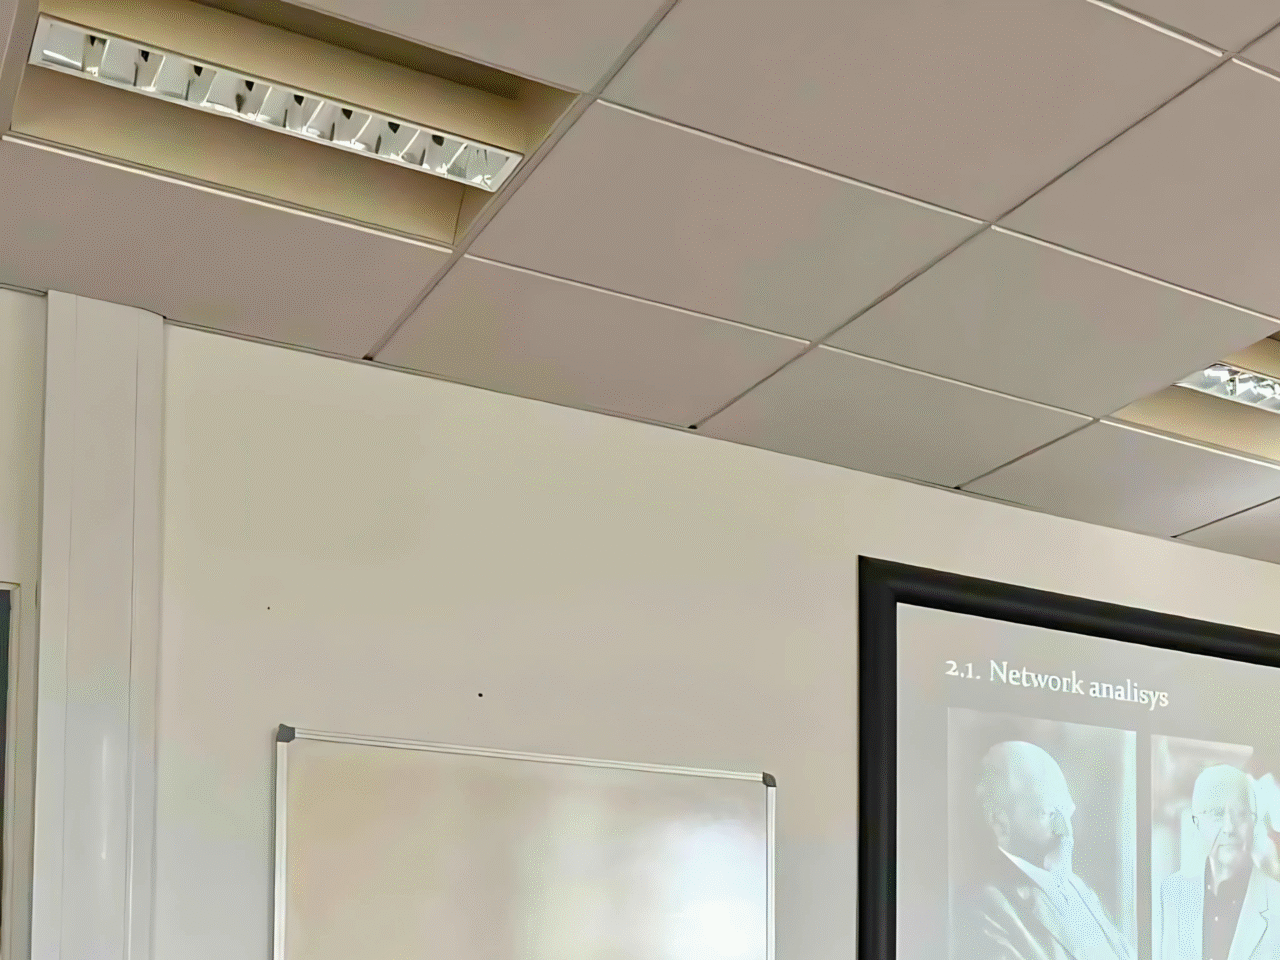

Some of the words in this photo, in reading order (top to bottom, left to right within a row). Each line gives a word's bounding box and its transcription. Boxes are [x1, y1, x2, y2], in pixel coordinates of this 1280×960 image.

[945, 660, 981, 680] 2.1.
[989, 659, 1085, 695] Network
[1088, 679, 1169, 711] analisys
